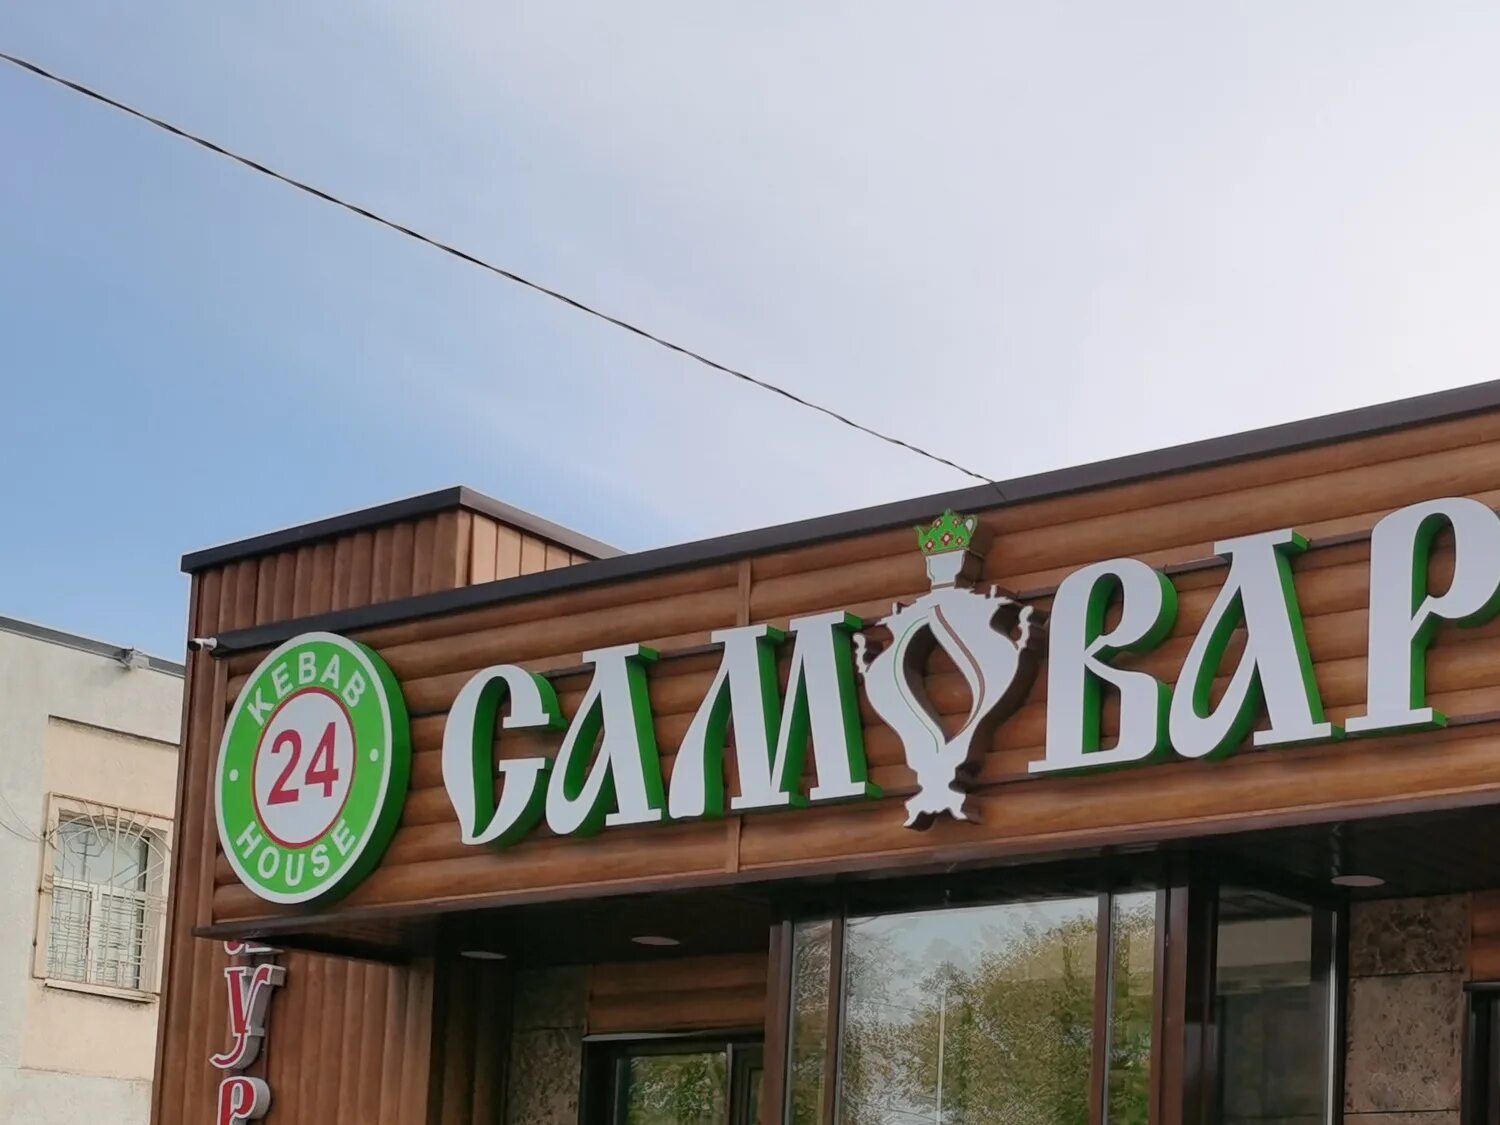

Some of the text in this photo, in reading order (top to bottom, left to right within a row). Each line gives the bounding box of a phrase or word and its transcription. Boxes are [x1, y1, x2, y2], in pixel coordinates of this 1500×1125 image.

[247, 651, 367, 726] KEBAB
[267, 722, 340, 806] 24
[236, 820, 356, 887] HOUSE
